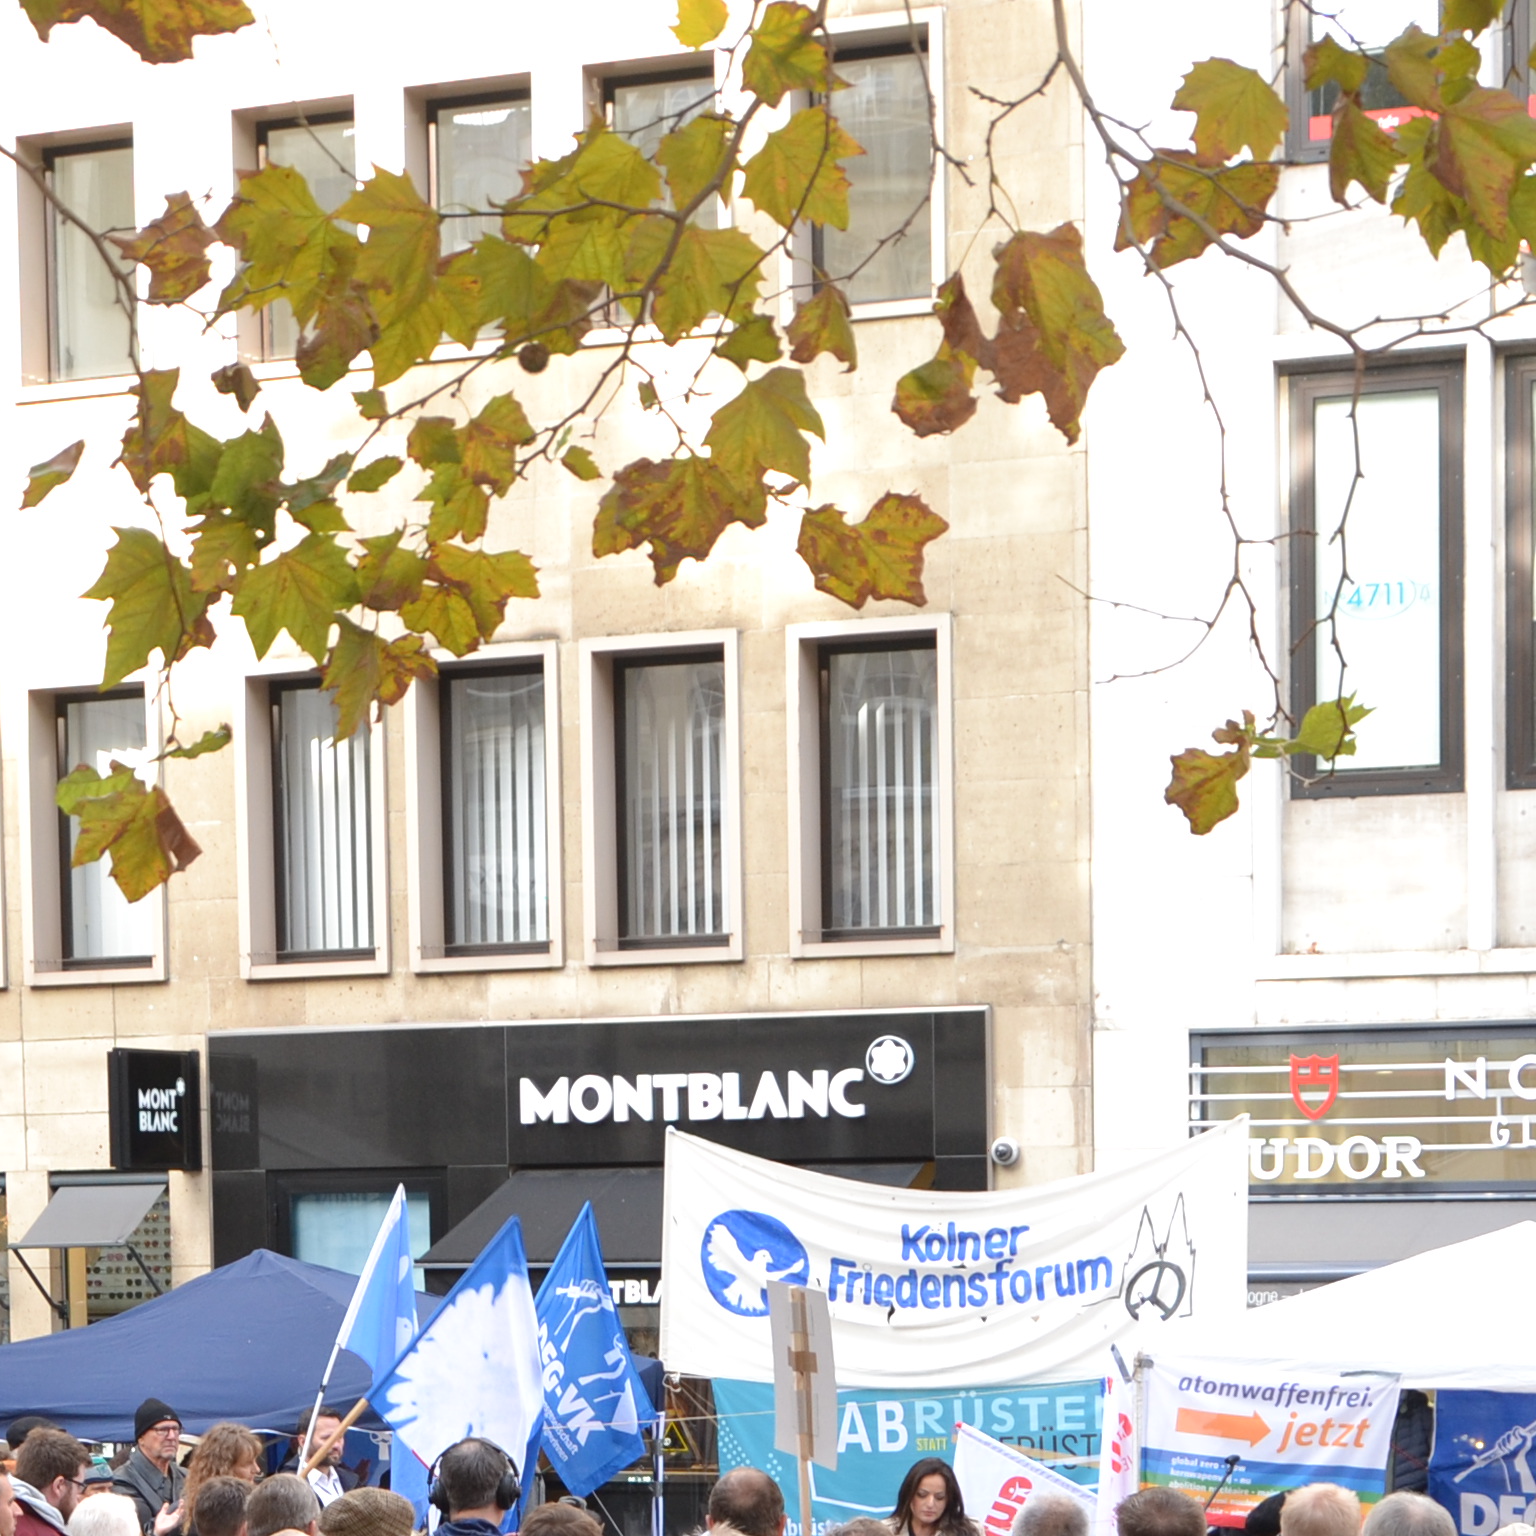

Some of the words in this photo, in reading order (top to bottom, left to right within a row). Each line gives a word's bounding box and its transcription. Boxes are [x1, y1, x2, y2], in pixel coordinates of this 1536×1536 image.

[1347, 581, 1406, 608] 4711
[138, 1088, 178, 1110] MONT
[519, 1068, 866, 1125] MONTBLANC
[139, 1110, 179, 1133] BLANC
[1248, 1134, 1427, 1180] UDOR
[828, 1256, 1114, 1310] Friedensforum
[1247, 1290, 1279, 1306] ogne
[1178, 1376, 1373, 1411] atomwaffenfrei.
[917, 1438, 948, 1451] STATT
[1276, 1411, 1371, 1453] jetzt
[1171, 1456, 1198, 1467] global
[1200, 1461, 1219, 1469] zero
